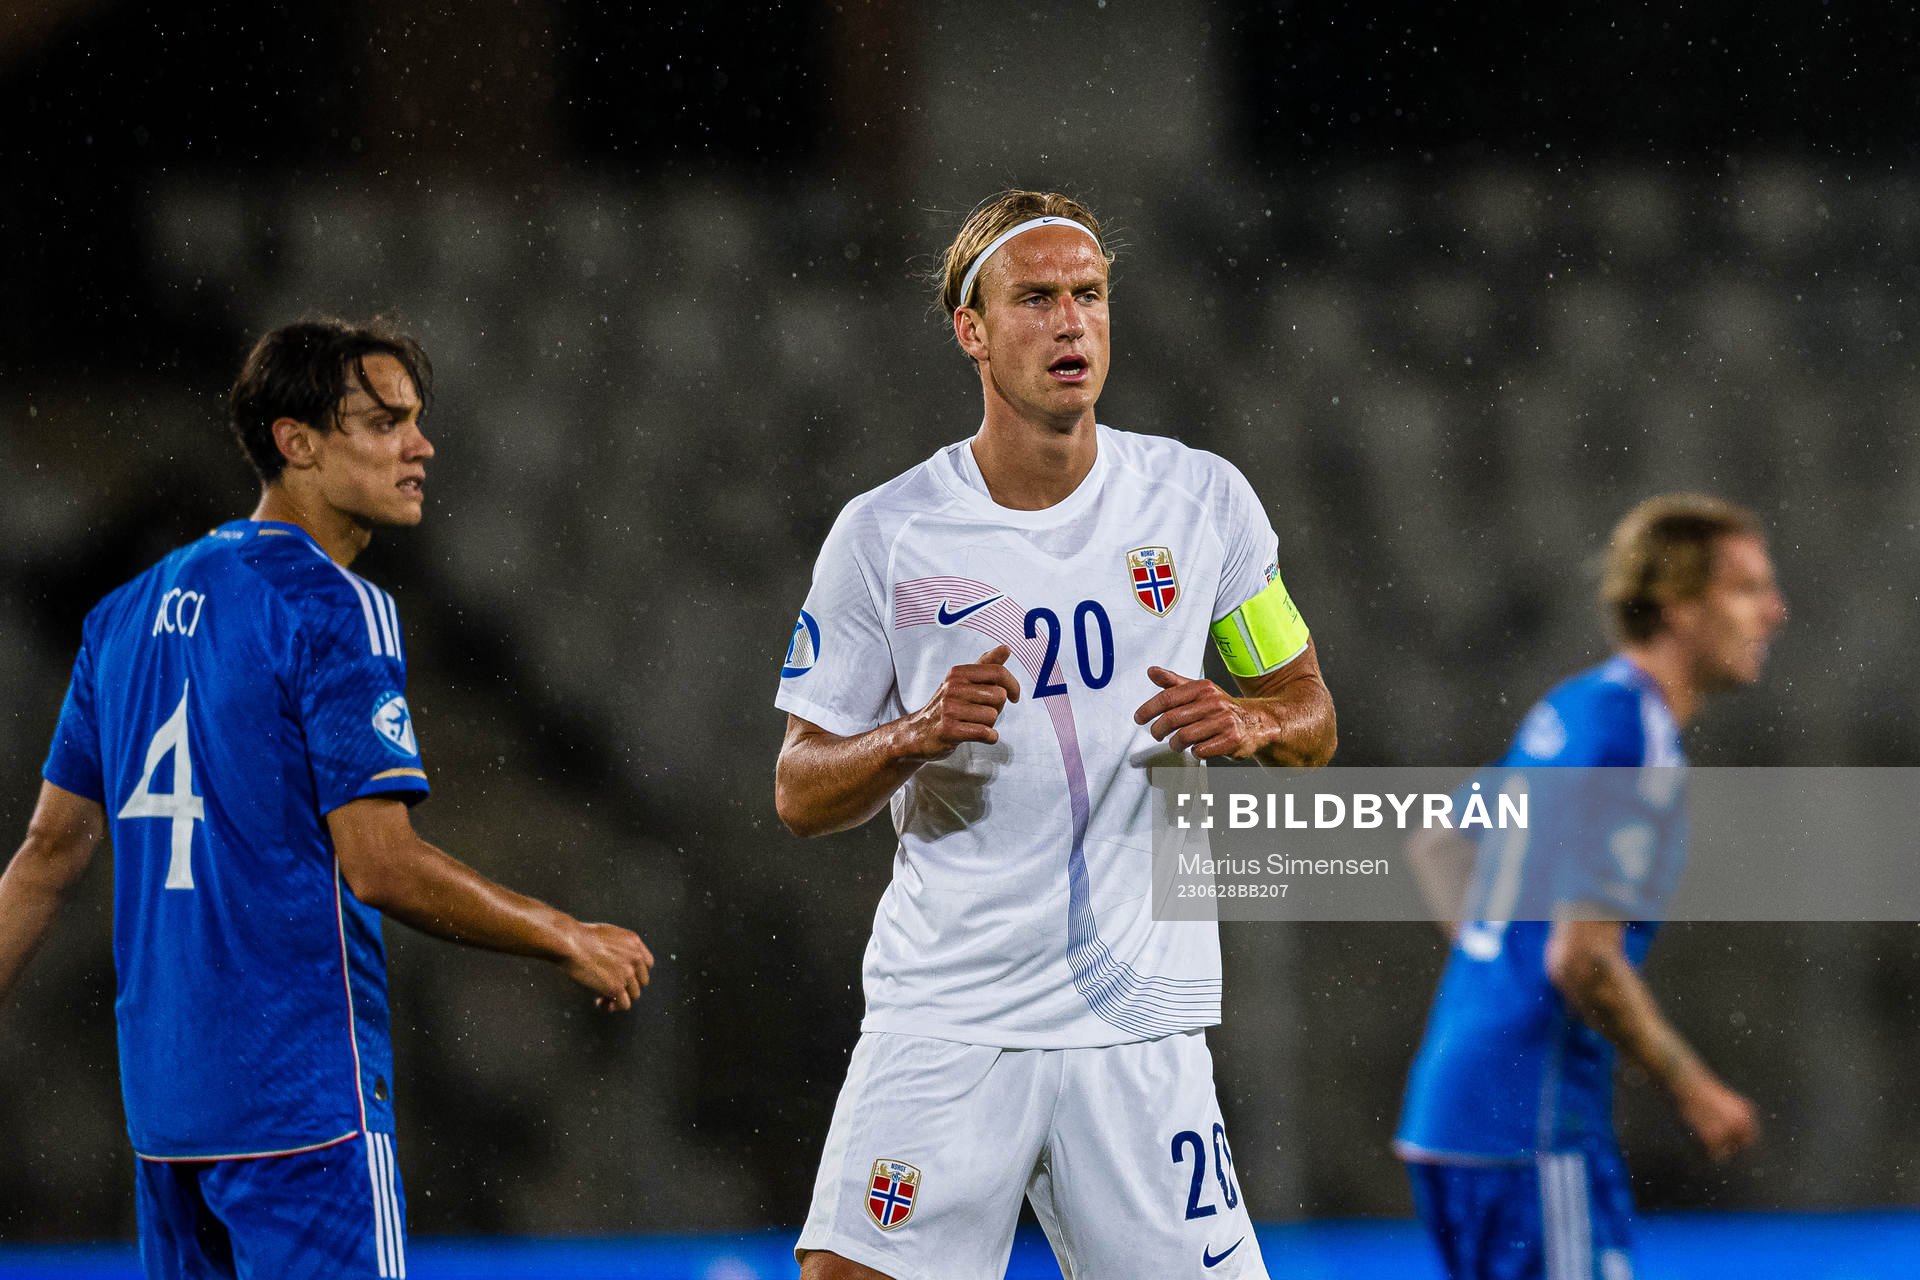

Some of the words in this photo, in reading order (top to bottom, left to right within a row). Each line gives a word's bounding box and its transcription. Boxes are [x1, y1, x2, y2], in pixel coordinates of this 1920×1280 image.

[1023, 599, 1115, 699] 20
[117, 678, 205, 890] 4
[1171, 1122, 1238, 1221] 20
